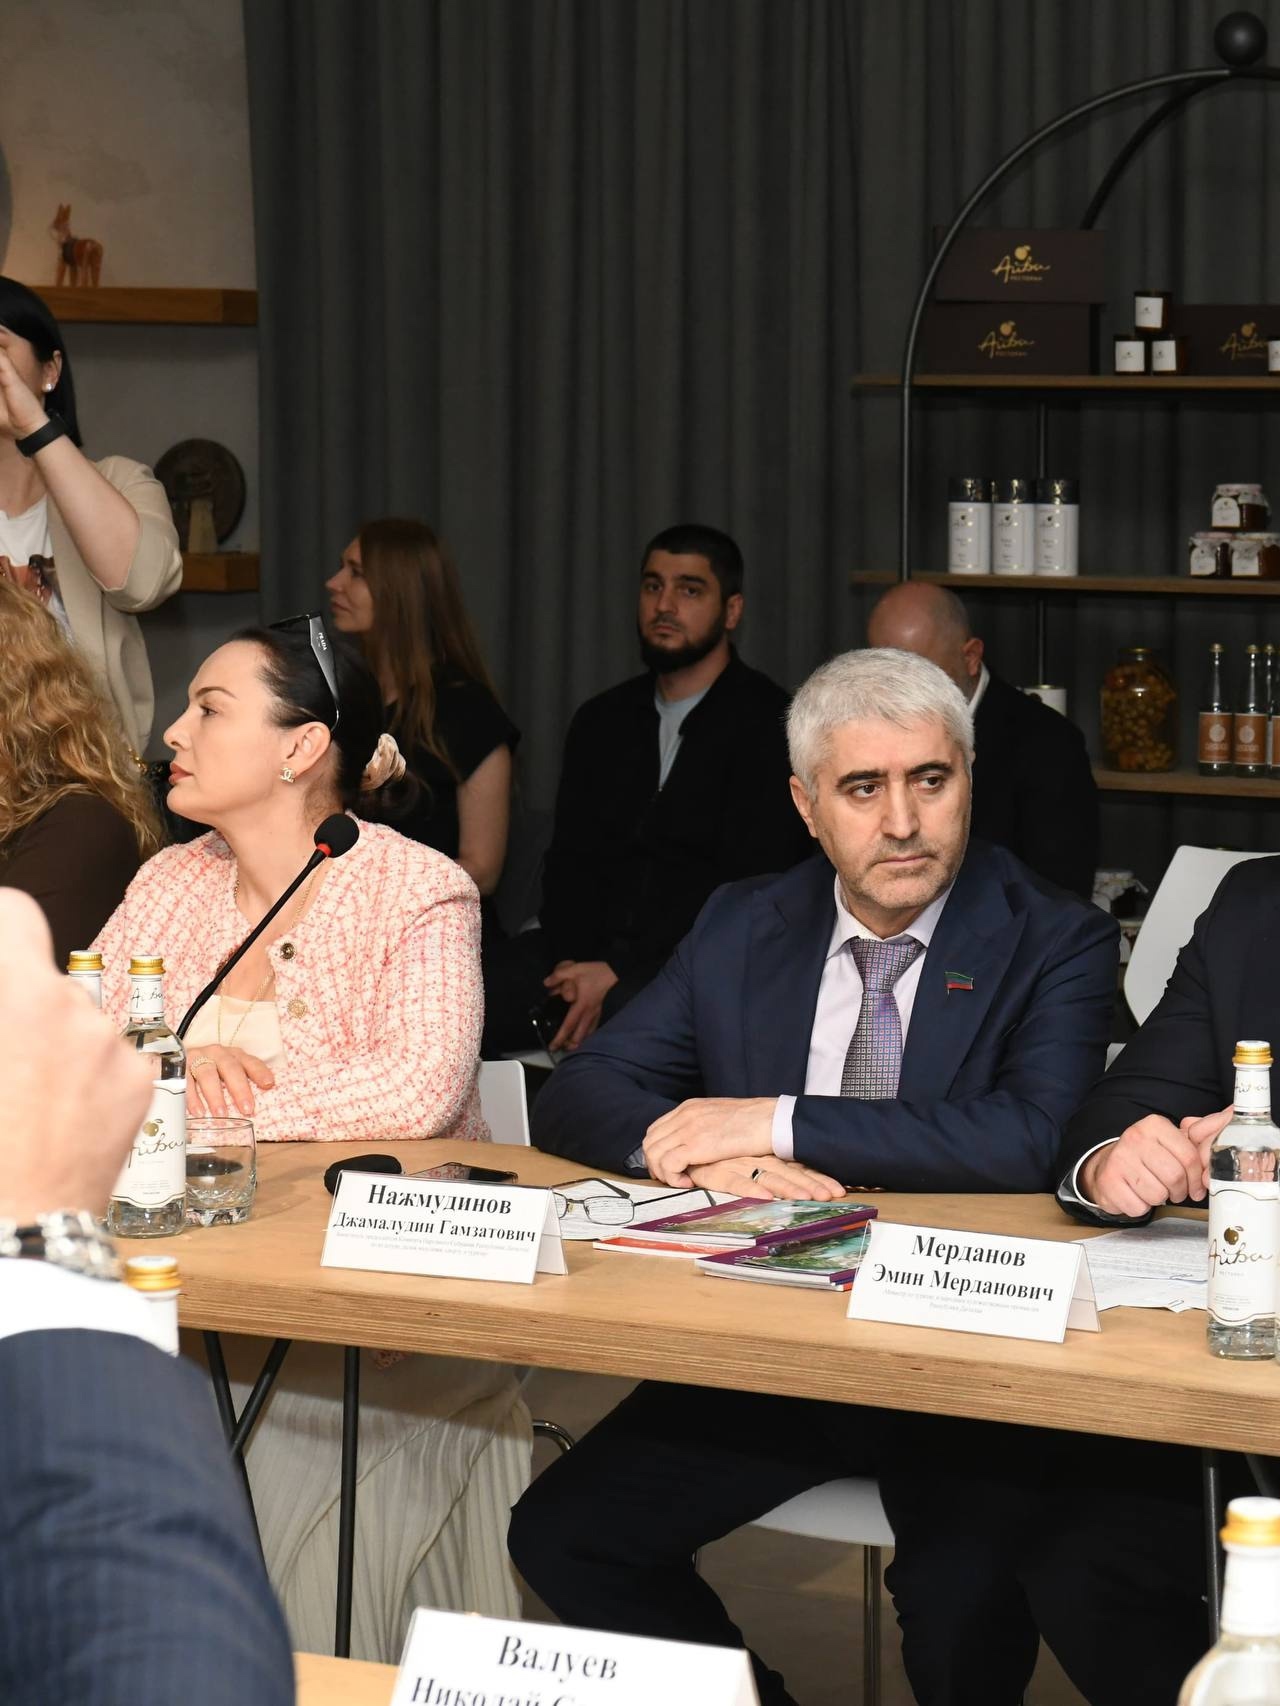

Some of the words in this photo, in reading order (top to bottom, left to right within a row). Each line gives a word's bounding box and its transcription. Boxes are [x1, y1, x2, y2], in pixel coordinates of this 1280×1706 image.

[992, 255, 1050, 284] Айва
[367, 1184, 512, 1214] Нажмудинов
[332, 1211, 434, 1235] Джамалудин
[438, 1220, 536, 1243] Гамзатович
[911, 1235, 1026, 1267] Мерданов
[871, 1263, 924, 1287] Эмин
[929, 1270, 1054, 1302] Мерданович
[497, 1635, 618, 1683] Валуев
